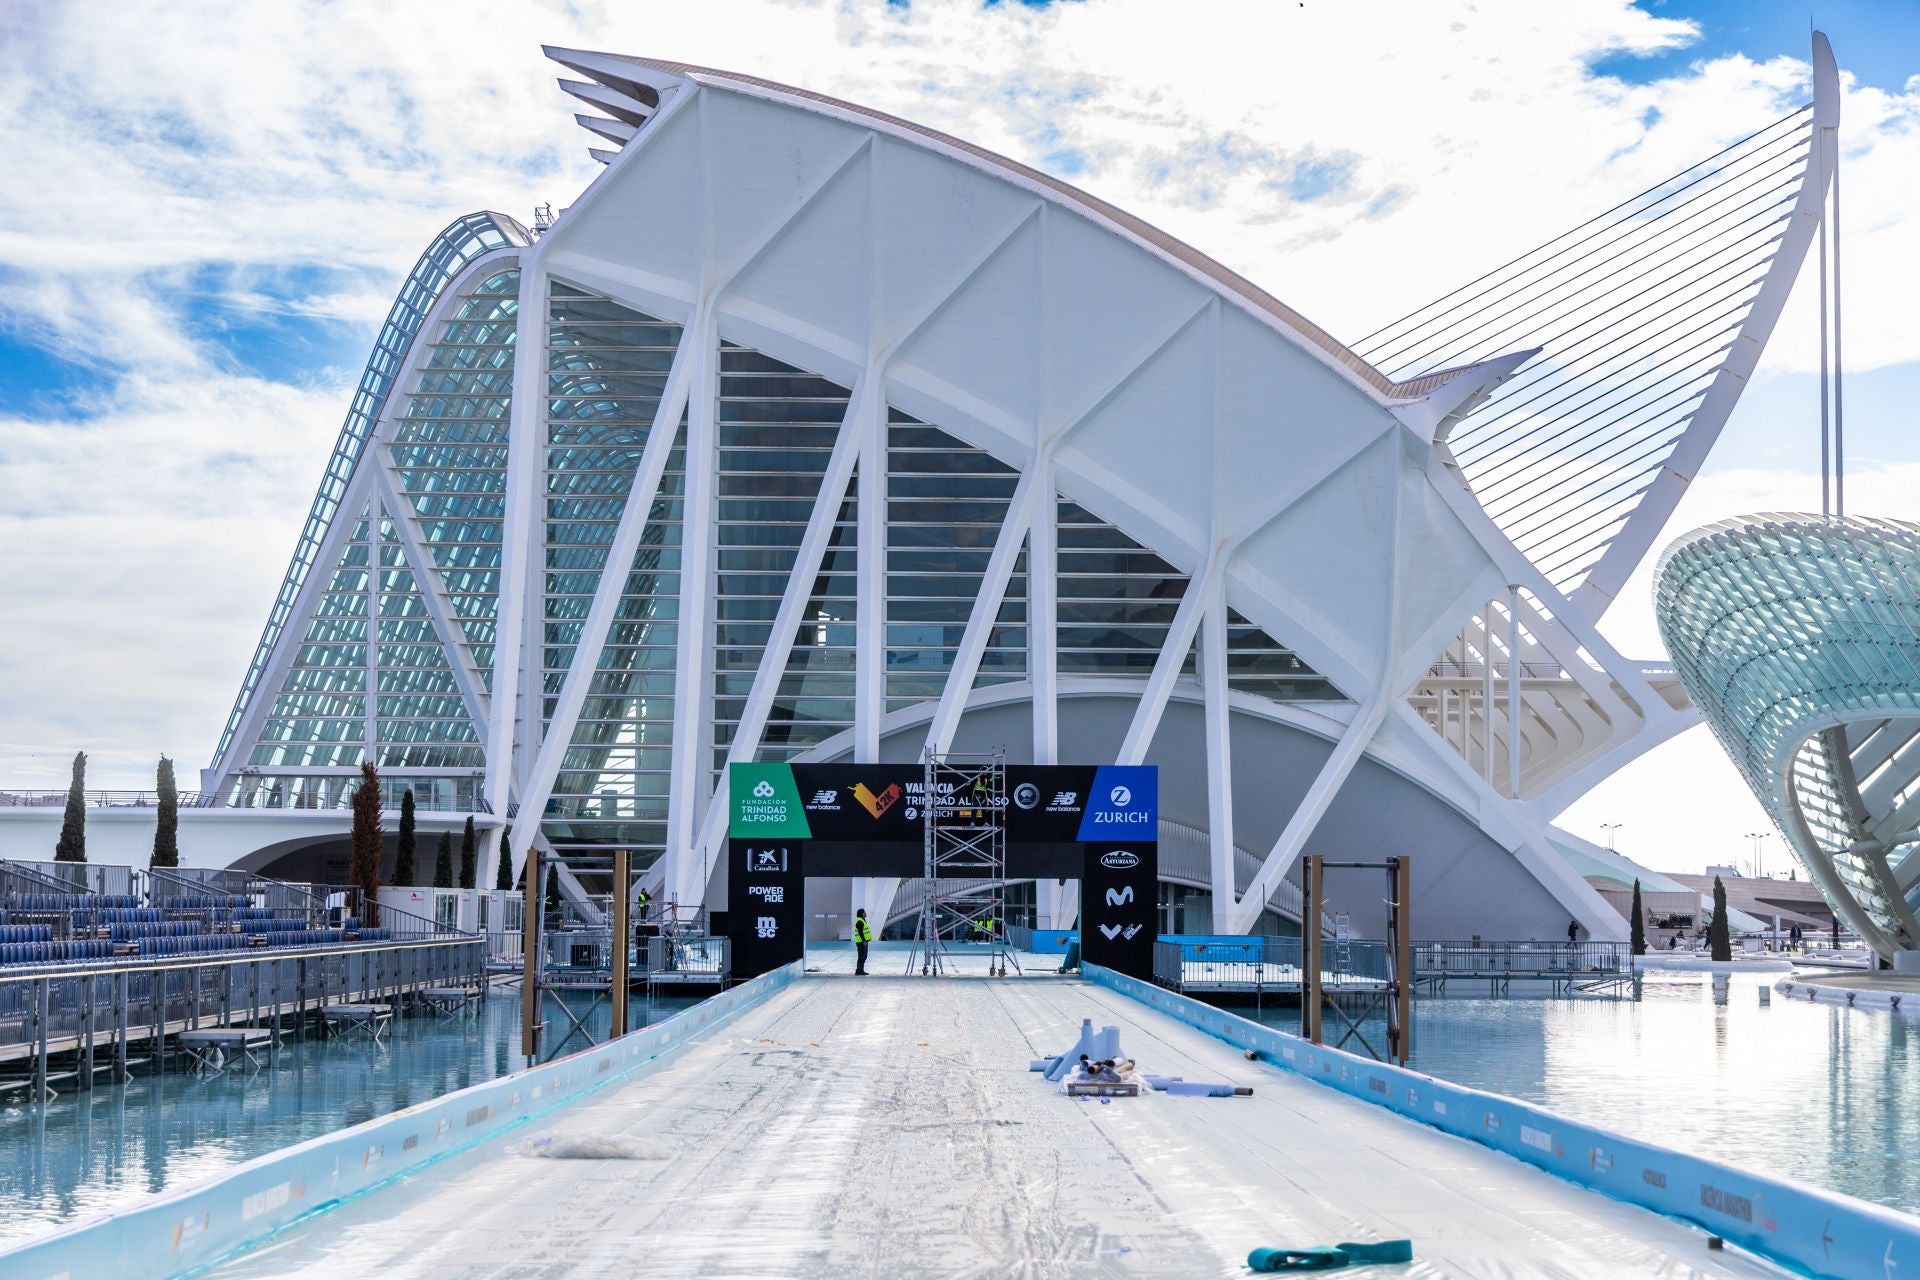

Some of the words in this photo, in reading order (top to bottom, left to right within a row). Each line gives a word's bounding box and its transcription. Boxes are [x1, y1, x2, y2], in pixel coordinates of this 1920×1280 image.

[905, 782, 954, 794] VALNCIA
[876, 789, 894, 811] 42K
[958, 796, 1010, 806] ALNSO
[1094, 812, 1148, 822] ZURICH
[748, 886, 784, 894] POWER
